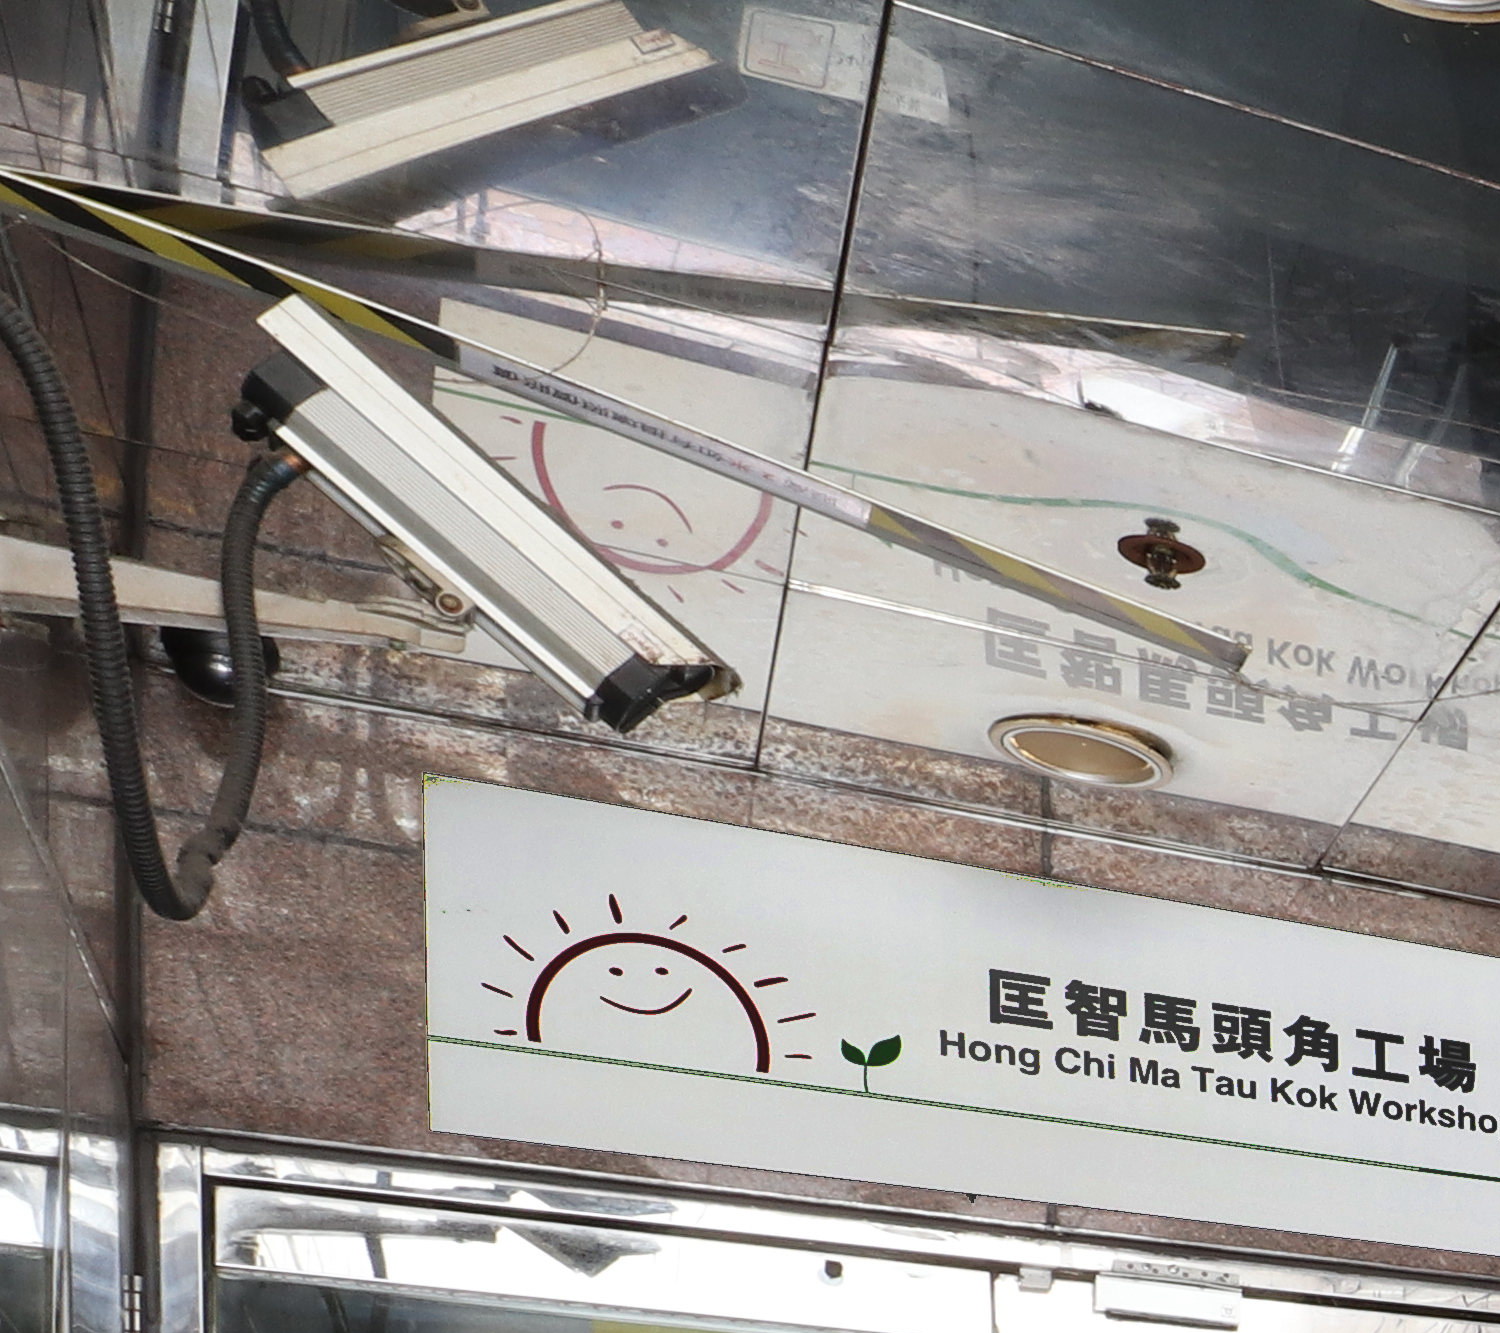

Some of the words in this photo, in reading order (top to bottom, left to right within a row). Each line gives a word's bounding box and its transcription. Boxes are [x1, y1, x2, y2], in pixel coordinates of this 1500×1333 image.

[938, 1028, 1042, 1077] Hong
[1054, 1046, 1117, 1081] Chi
[1128, 1055, 1182, 1091] Ma
[1190, 1064, 1258, 1101] Tau
[1270, 1076, 1340, 1113] Kok
[988, 967, 1477, 1094] 匡智馬頭角工場
